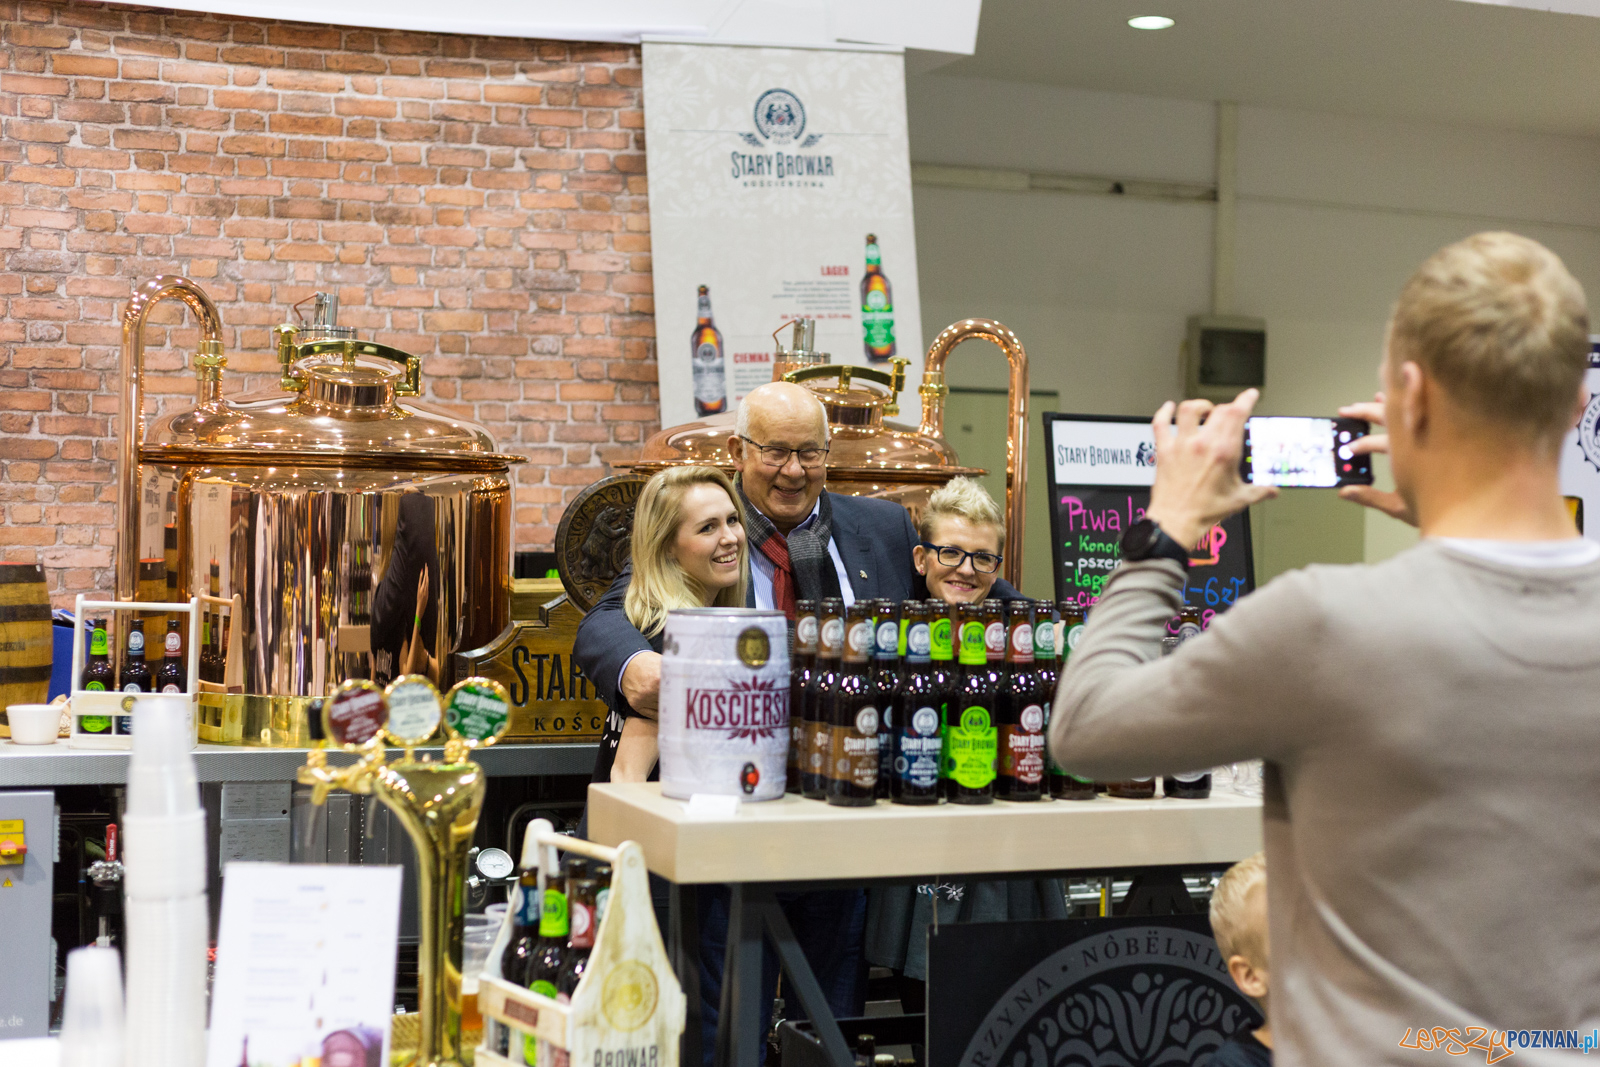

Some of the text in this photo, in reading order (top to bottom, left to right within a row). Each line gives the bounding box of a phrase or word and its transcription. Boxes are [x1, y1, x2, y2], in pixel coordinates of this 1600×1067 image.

[731, 151, 834, 178] STARY BROWAR
[1058, 445, 1132, 467] STARY BROWAR
[510, 645, 601, 708] STAR
[971, 975, 1052, 1067] RZYNA
